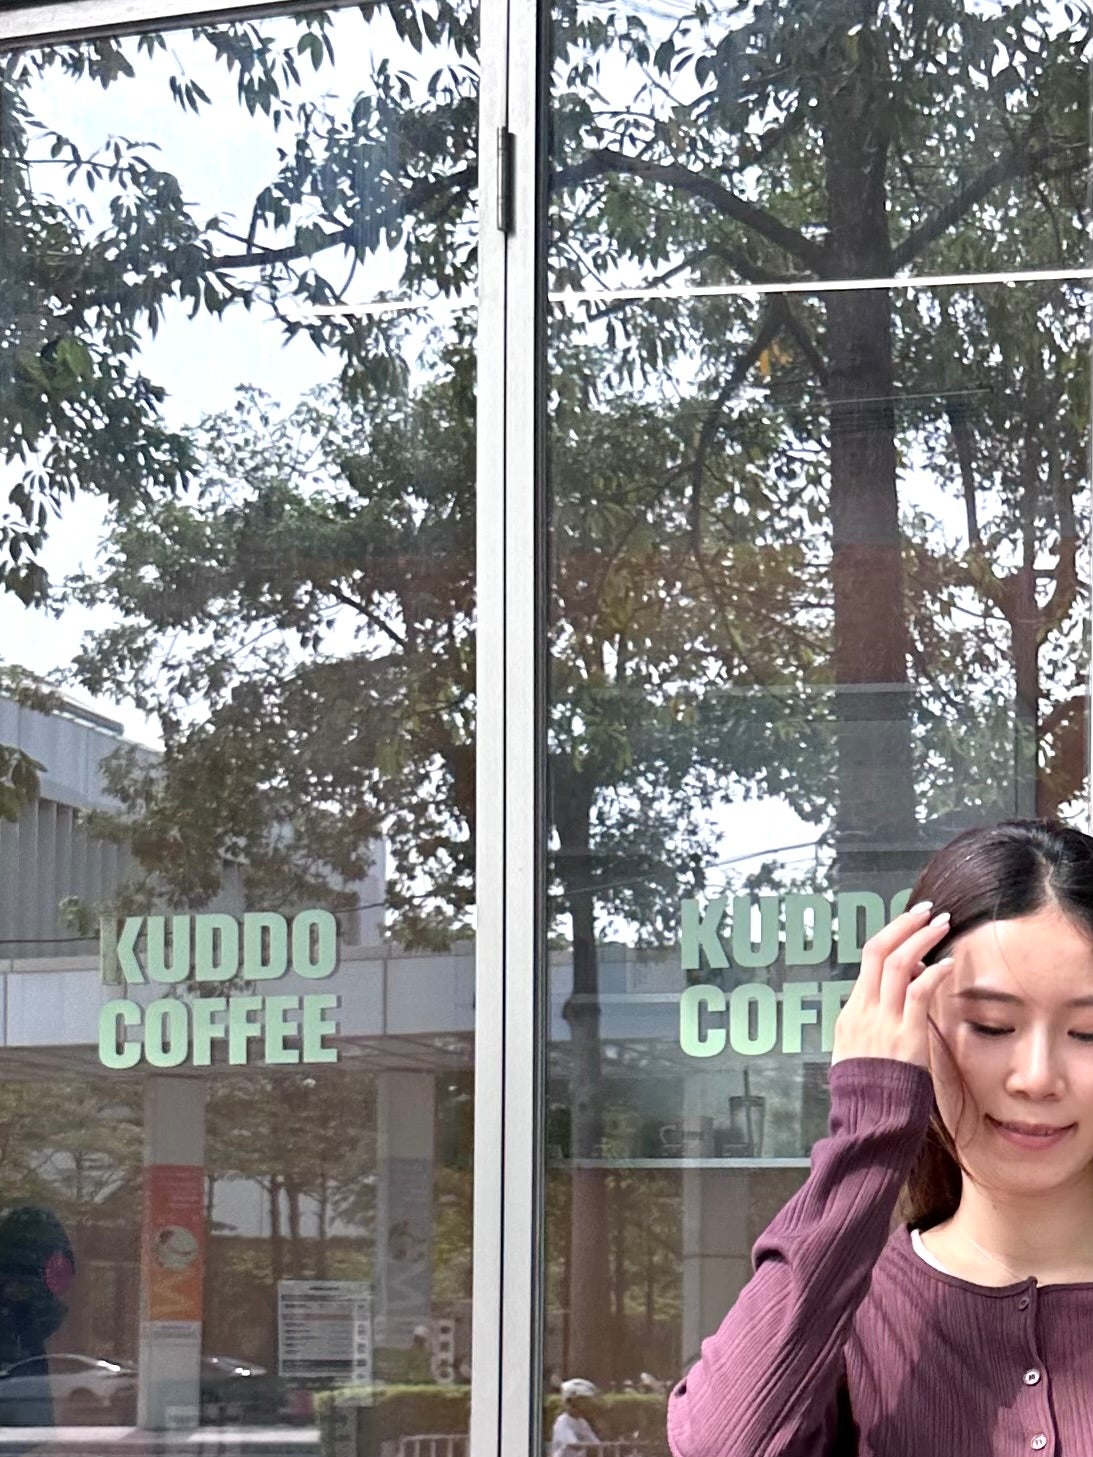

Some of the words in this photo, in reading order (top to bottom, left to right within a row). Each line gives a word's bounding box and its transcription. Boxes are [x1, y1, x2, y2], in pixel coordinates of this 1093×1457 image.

[101, 909, 338, 985] KUDDO
[681, 888, 912, 970] KUDD
[99, 994, 338, 1069] COFFEE
[680, 980, 856, 1057] COFF
